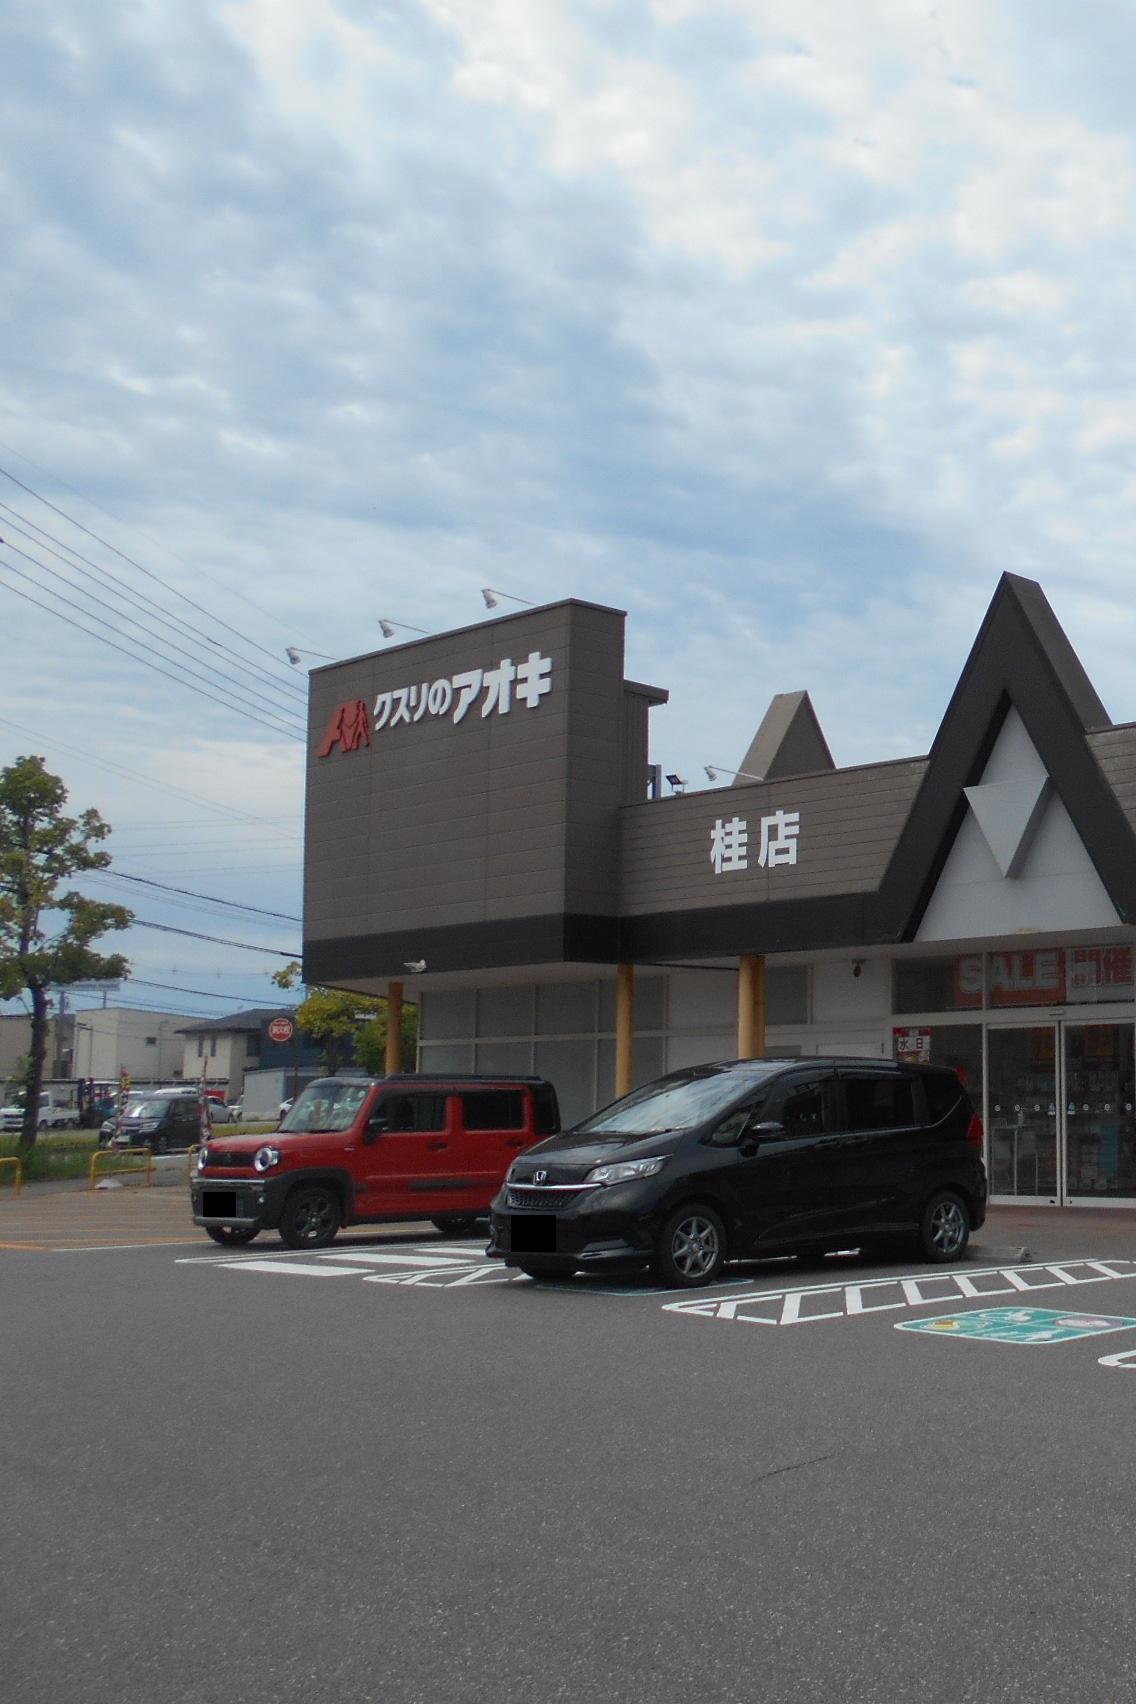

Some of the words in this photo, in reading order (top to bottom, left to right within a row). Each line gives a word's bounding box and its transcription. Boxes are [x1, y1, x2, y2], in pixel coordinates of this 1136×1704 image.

[373, 651, 553, 731] クスリのアオキ
[710, 809, 801, 874] 桂店
[958, 950, 1060, 994] SALE
